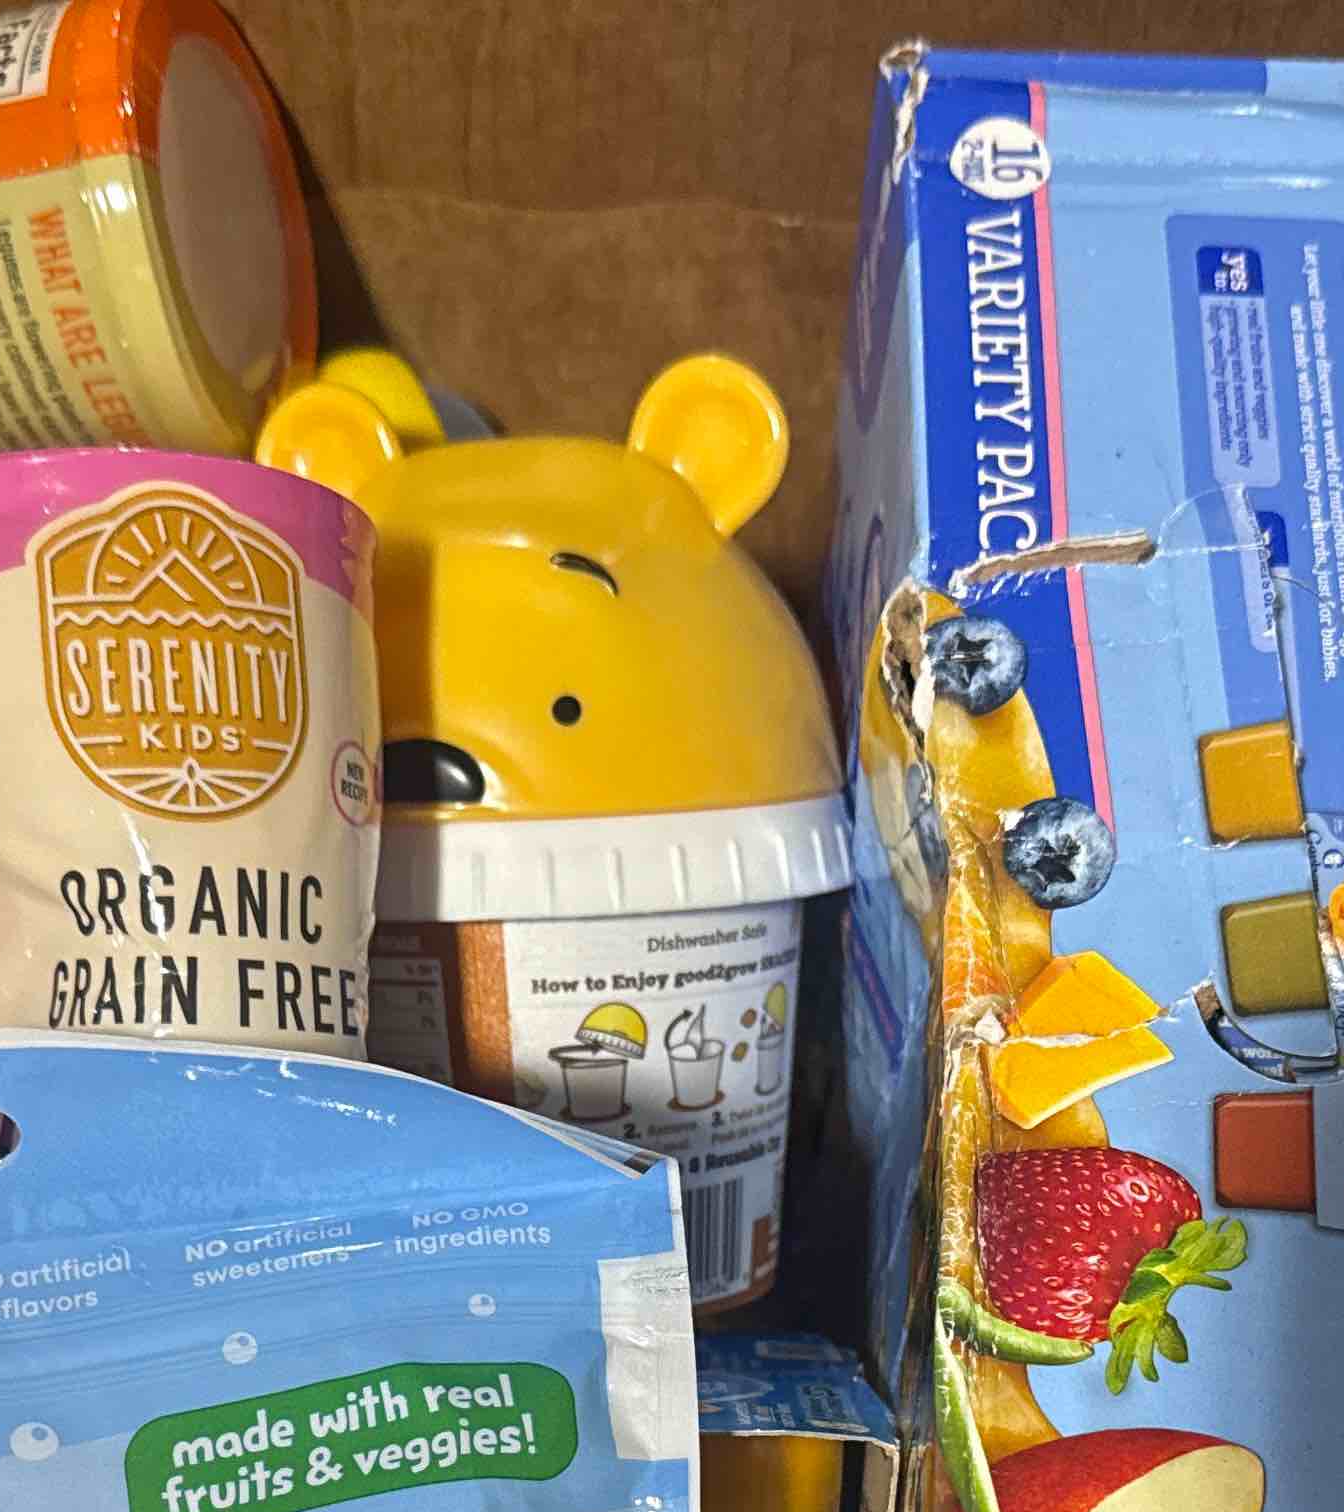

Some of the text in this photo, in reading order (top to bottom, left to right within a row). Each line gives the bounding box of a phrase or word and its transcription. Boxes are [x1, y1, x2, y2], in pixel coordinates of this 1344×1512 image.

[990, 140, 1042, 182] 16
[28, 209, 100, 369] WHAT ARE
[1222, 252, 1248, 293] yes
[965, 213, 1040, 566] VARIETY PAC
[67, 633, 289, 727] SERENITY
[137, 722, 239, 754] KIDS
[58, 865, 325, 947] ORGANIC
[647, 927, 738, 953] Dishwasher
[49, 958, 201, 1032] GRAIN
[237, 960, 362, 1038] FREE
[532, 963, 756, 995] How to Enjoy good2grow
[411, 1201, 529, 1230] NO GMO
[184, 1220, 353, 1263] NO artificial
[394, 1220, 552, 1257] ingredients
[9, 1245, 131, 1289] artificial
[0, 1287, 99, 1320] flavors
[171, 1373, 515, 1469] made with real
[306, 1450, 343, 1485] &
[353, 1412, 536, 1479] veggies!
